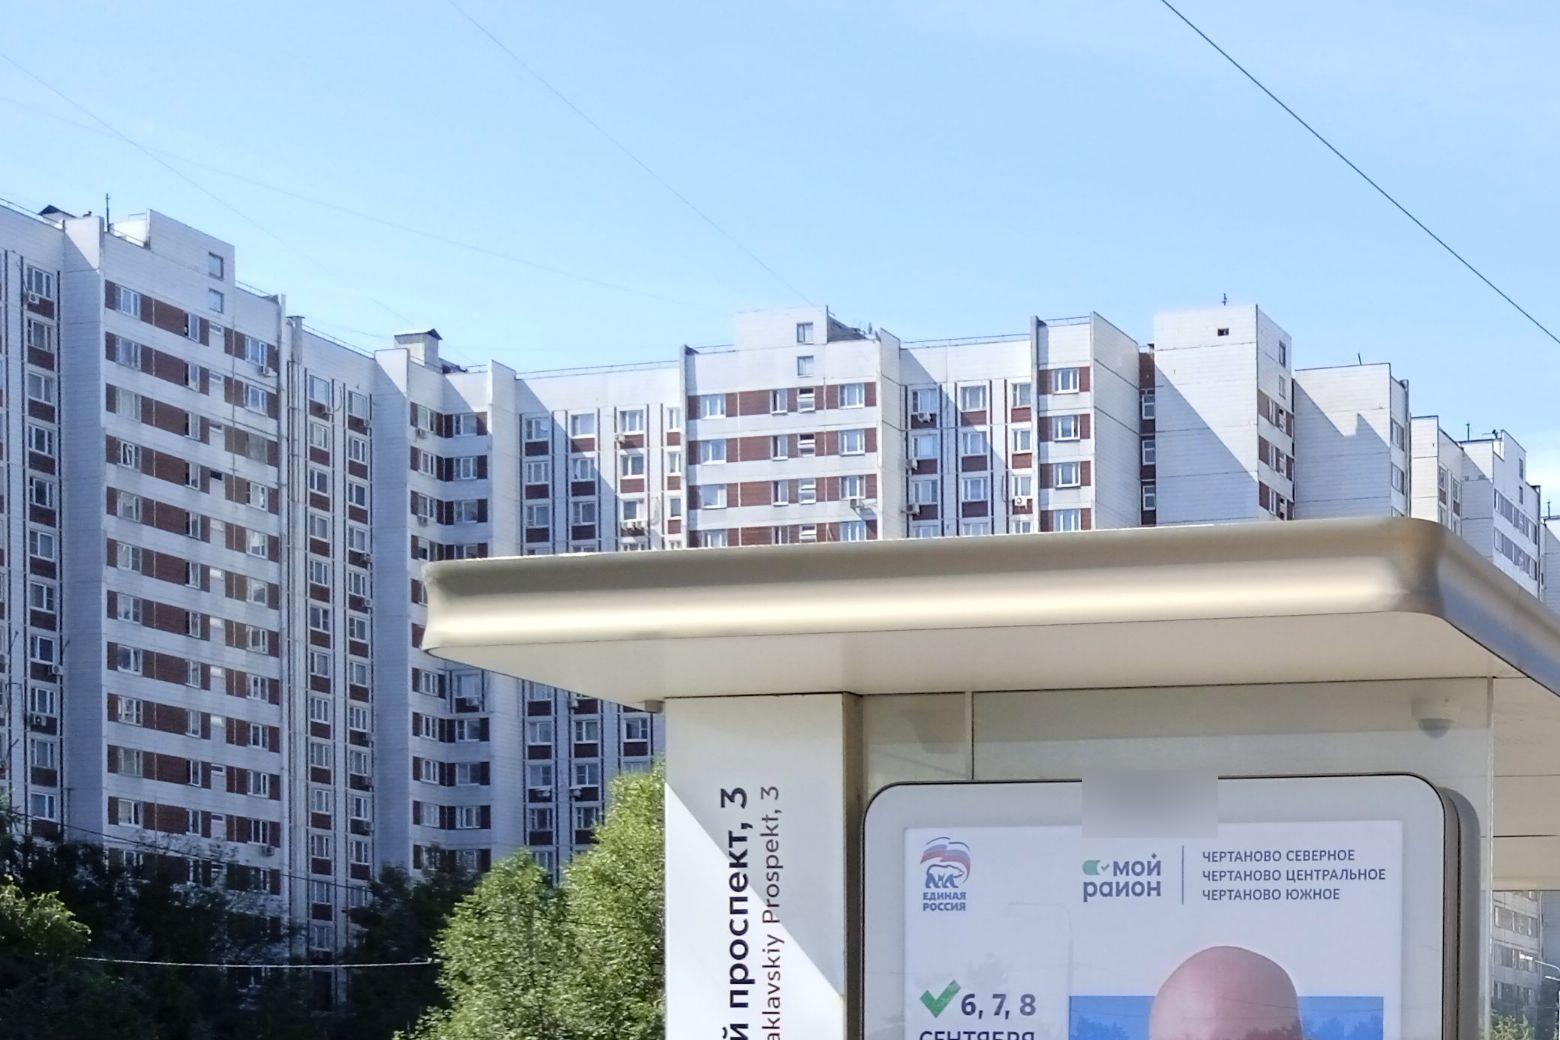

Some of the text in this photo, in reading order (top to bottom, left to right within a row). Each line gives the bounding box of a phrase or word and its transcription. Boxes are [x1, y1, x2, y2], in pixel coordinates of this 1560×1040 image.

[720, 787, 748, 809] 3
[760, 785, 780, 800] 3
[1202, 848, 1356, 863] ЧЕРТАНОВО СЕВЕРНОЕ
[760, 809, 784, 924] Prospekt,
[1202, 867, 1387, 883] ЧЕРТАНОВО ЦЕНТРАЛЬНОЕ
[922, 891, 967, 901] ЕДИНАЯ
[1202, 887, 1341, 901] ЧЕРТАНОВО ЮЖНОЕ
[922, 902, 966, 911] РОССИЯ
[728, 822, 755, 1009] проспект,
[1019, 993, 1037, 1017] 8
